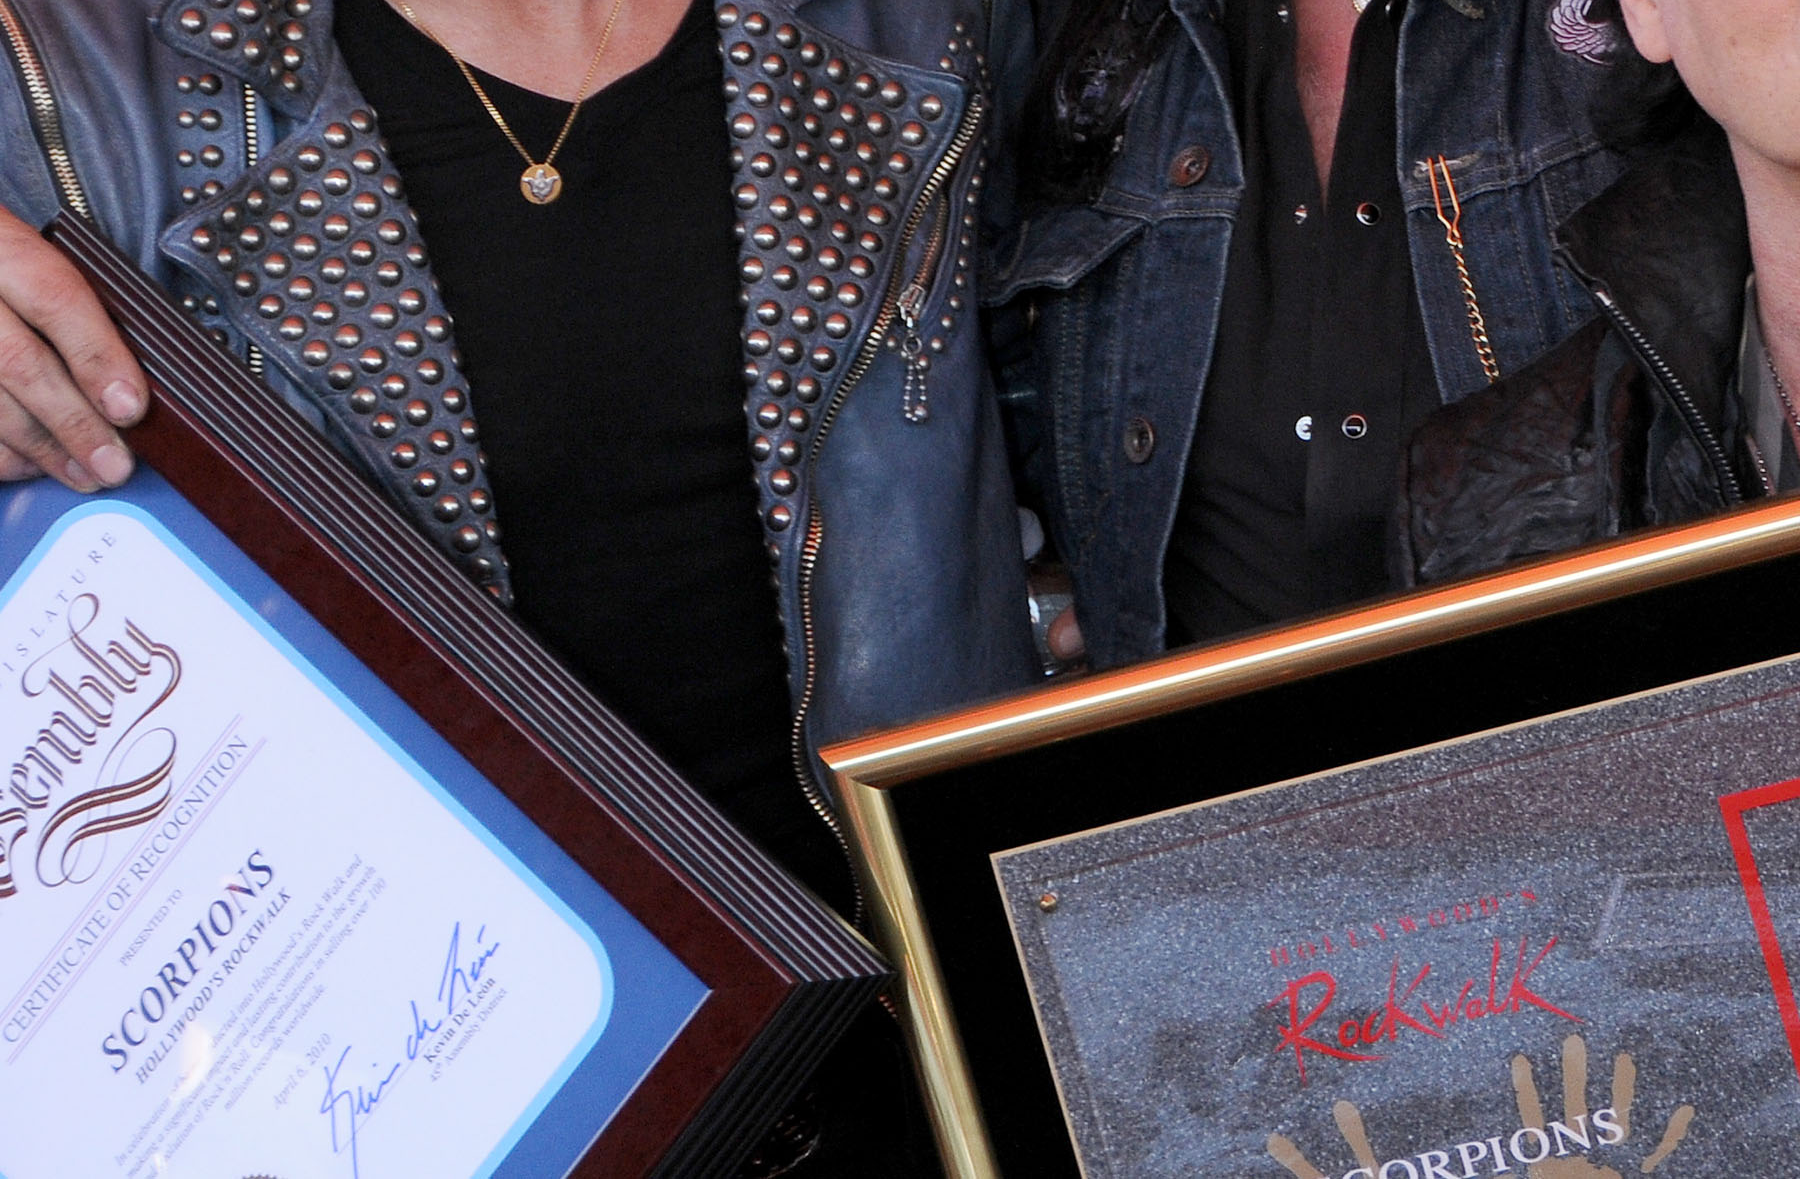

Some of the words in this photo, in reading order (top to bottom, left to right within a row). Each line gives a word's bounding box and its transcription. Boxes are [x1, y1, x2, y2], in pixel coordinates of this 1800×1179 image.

[0, 593, 181, 898] sembly
[2, 909, 112, 1043] CERTIFICATE
[106, 877, 132, 912] OF
[128, 734, 249, 882] RECOGNITION
[119, 905, 170, 967] PRESENTED
[166, 888, 184, 906] TO
[101, 849, 274, 1074] SCORPIONS
[135, 971, 225, 1085] HOLLYWOOD'S
[221, 887, 292, 976] ROCKWALK
[305, 1032, 332, 1067] 2010
[422, 1027, 457, 1064] Kevin
[451, 1008, 471, 1027] De
[466, 977, 497, 1009] León
[443, 1021, 481, 1066] Assembly
[476, 987, 508, 1023] District
[1321, 1107, 1626, 1179] ORPIONS
